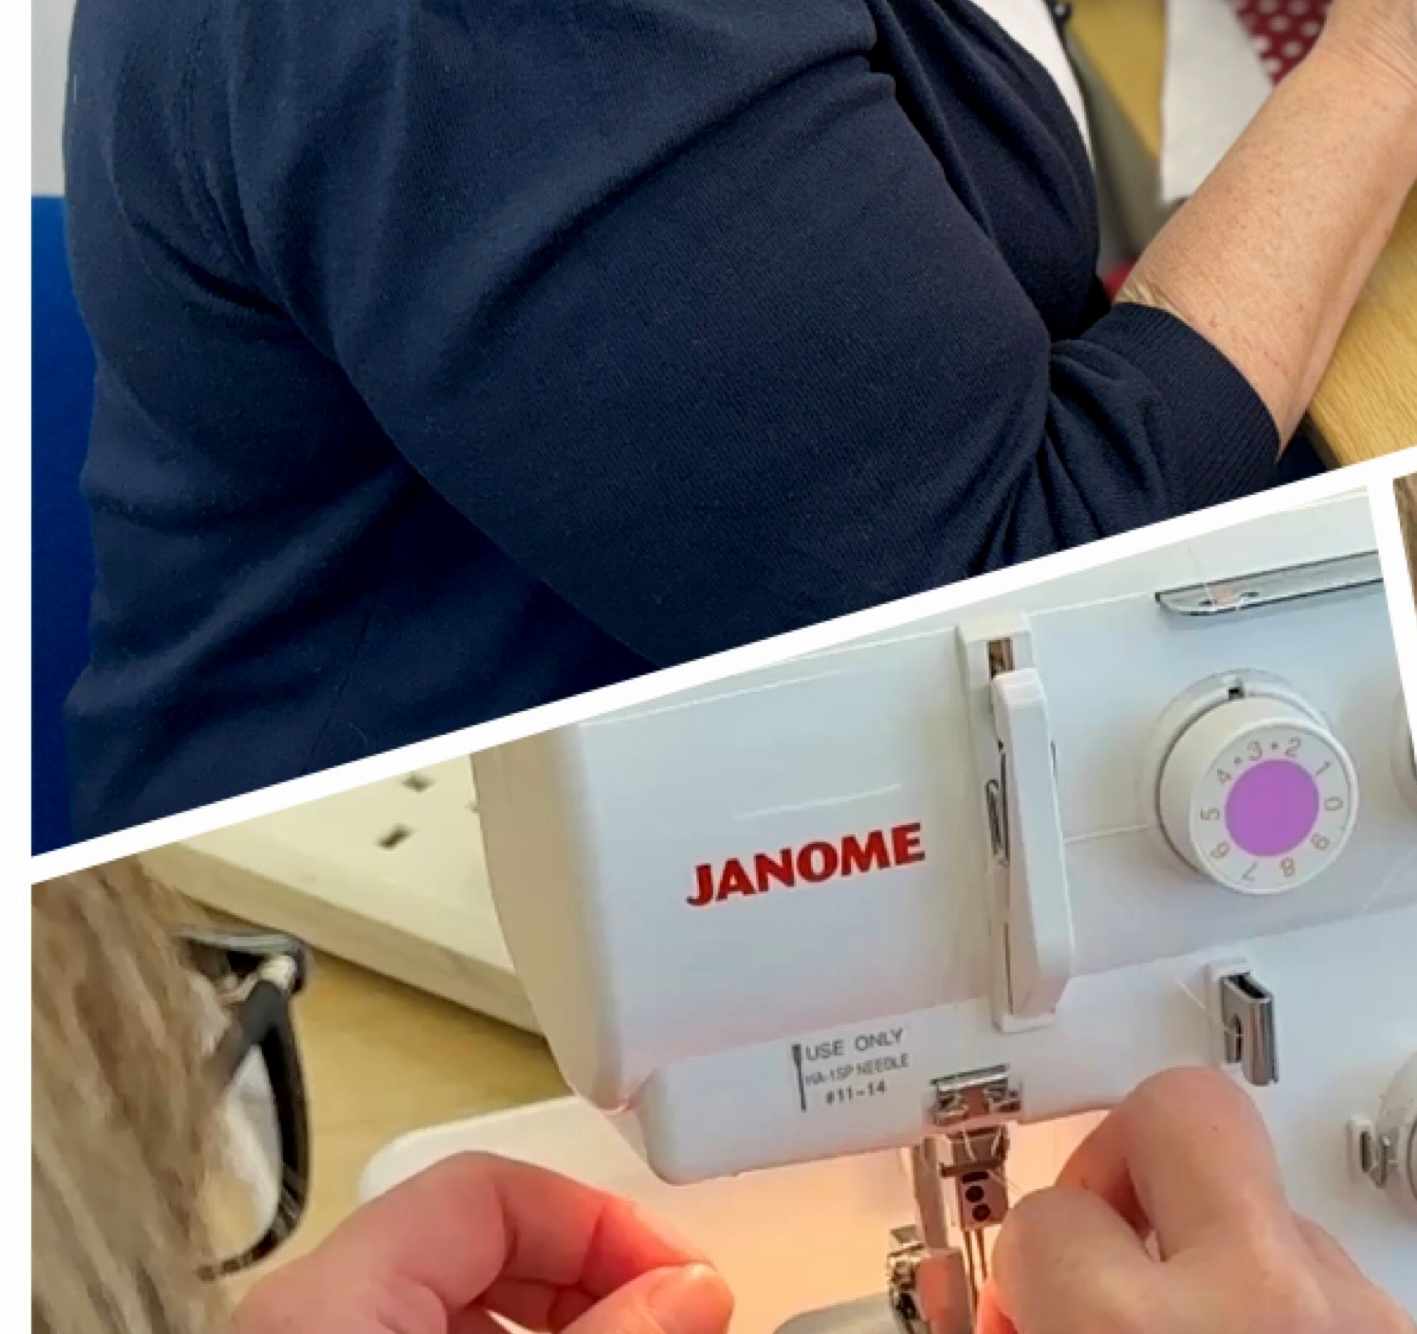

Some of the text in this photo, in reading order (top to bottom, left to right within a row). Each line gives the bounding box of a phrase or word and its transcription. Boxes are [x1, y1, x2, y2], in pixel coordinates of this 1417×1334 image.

[1200, 736, 1344, 881] 4 3 2 1 0 9 8 7 6 5
[686, 822, 925, 907] JANOME
[805, 1026, 904, 1061] USE ONLY
[855, 1052, 910, 1076] NEEDLE
